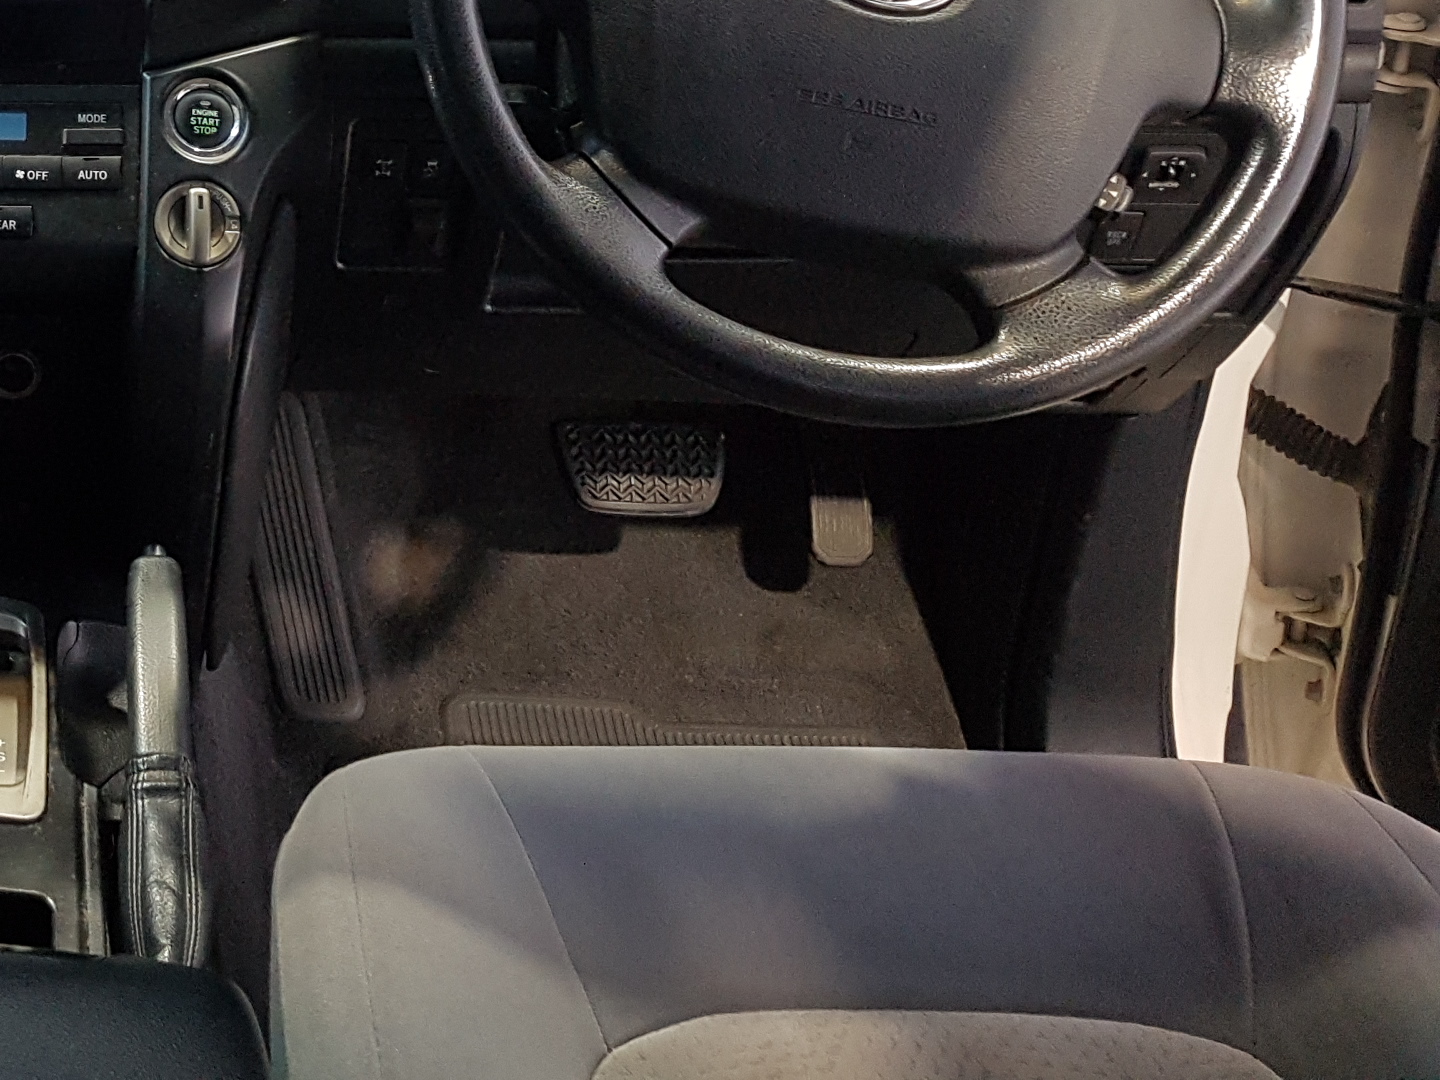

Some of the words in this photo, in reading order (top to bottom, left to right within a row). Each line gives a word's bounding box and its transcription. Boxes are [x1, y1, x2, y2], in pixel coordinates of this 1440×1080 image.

[192, 109, 219, 117] ENGINE
[78, 113, 106, 123] MODE
[190, 117, 221, 126] START
[193, 125, 217, 134] STOP
[27, 169, 49, 181] OFF
[78, 169, 108, 180] AUTO
